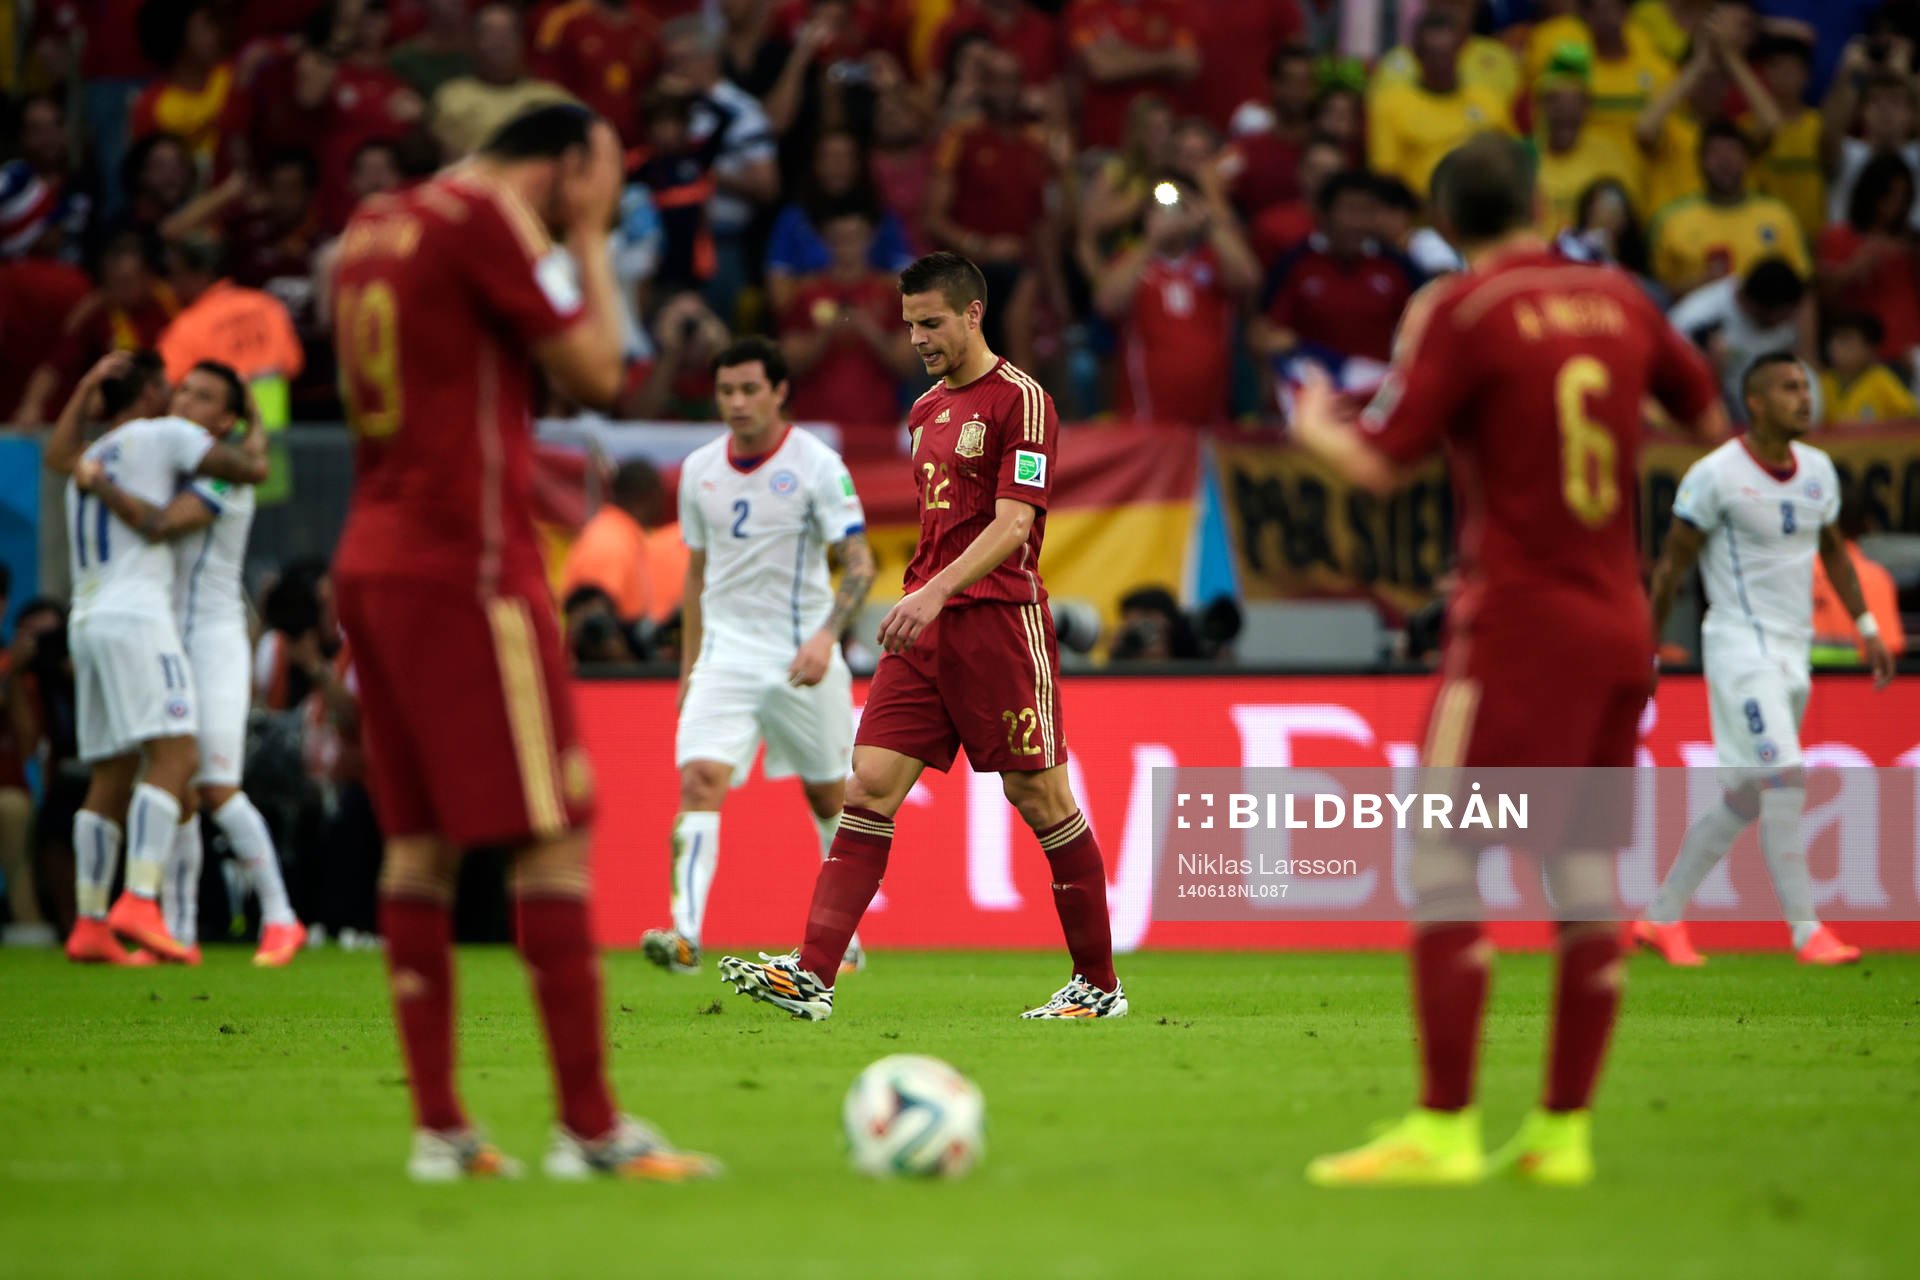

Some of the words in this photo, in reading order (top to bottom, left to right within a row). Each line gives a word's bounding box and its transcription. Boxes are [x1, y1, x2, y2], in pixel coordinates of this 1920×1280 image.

[1555, 355, 1620, 529] 6
[923, 462, 951, 510] 22
[732, 498, 750, 539] 2
[1779, 501, 1797, 535] 8
[160, 653, 186, 689] 11
[1002, 707, 1042, 756] 22
[1743, 697, 1766, 735] 8
[846, 703, 1179, 956] ly
